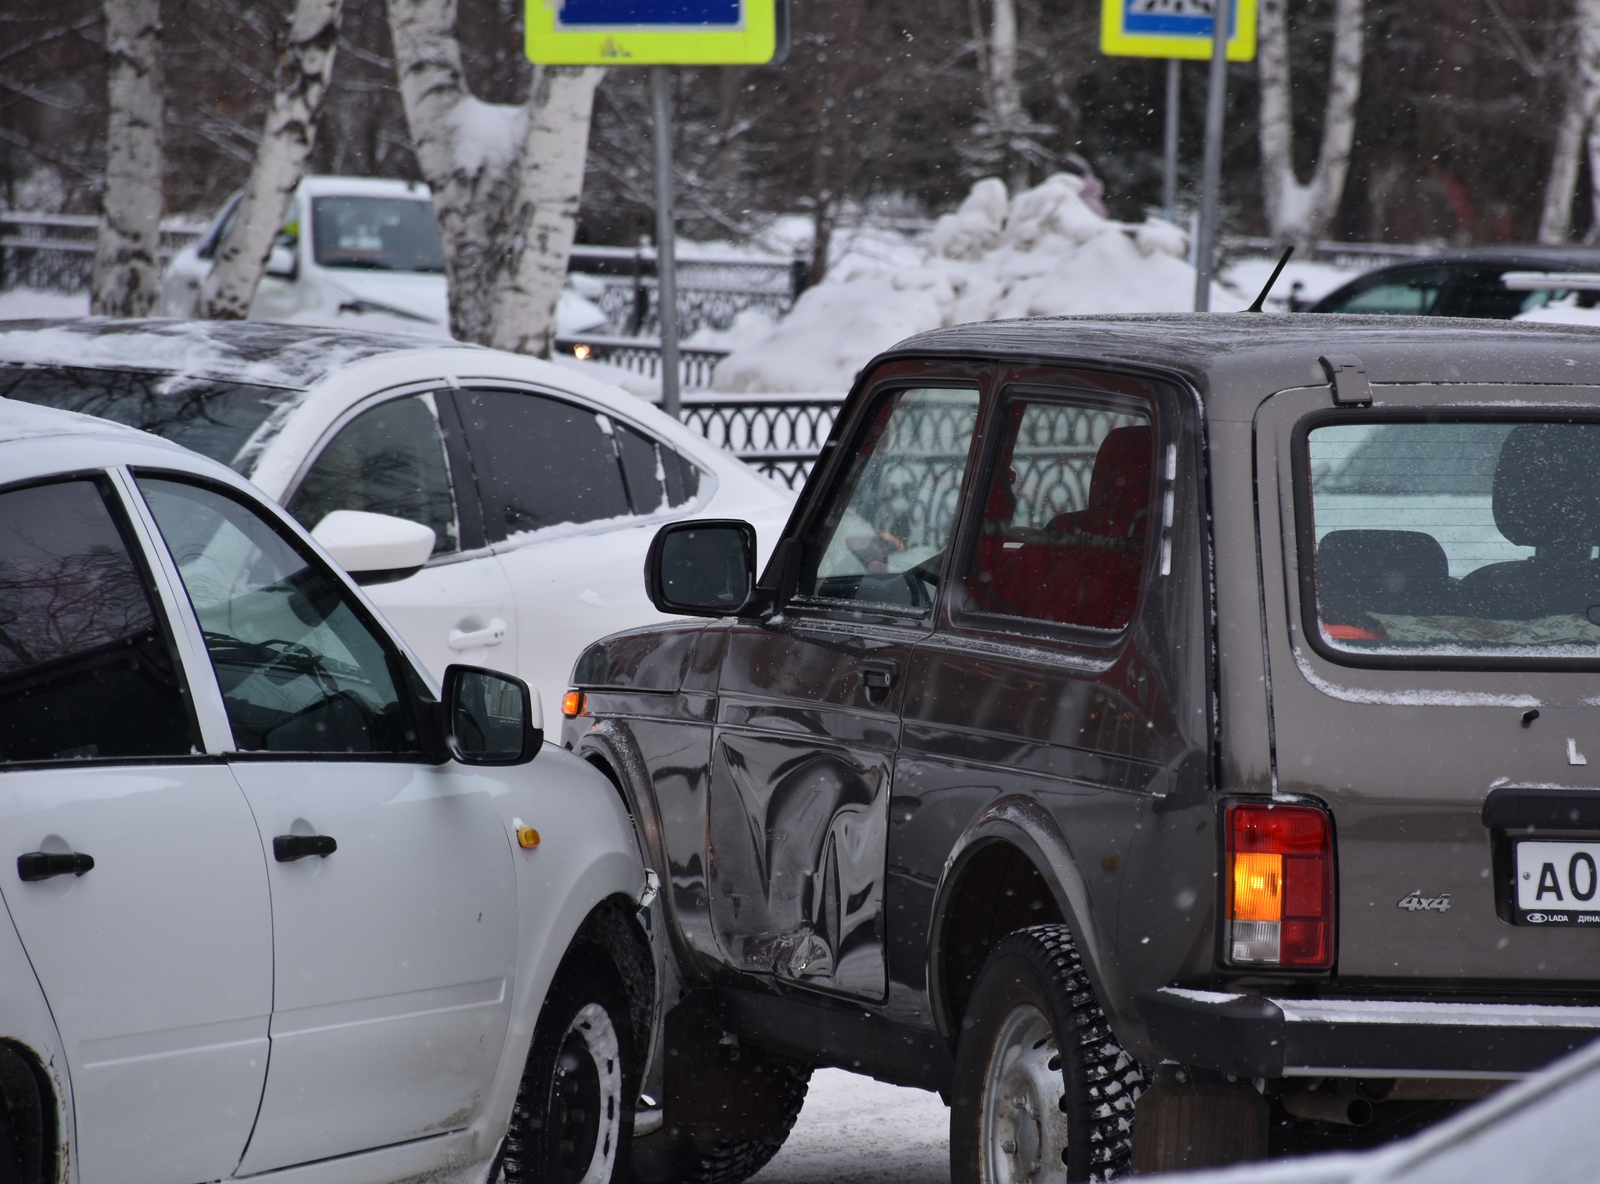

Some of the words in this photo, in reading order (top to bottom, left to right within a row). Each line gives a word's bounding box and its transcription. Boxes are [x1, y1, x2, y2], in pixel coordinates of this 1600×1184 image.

[1567, 738, 1587, 765] L
[1397, 890, 1451, 912] 4x4
[1548, 914, 1569, 922] LADA
